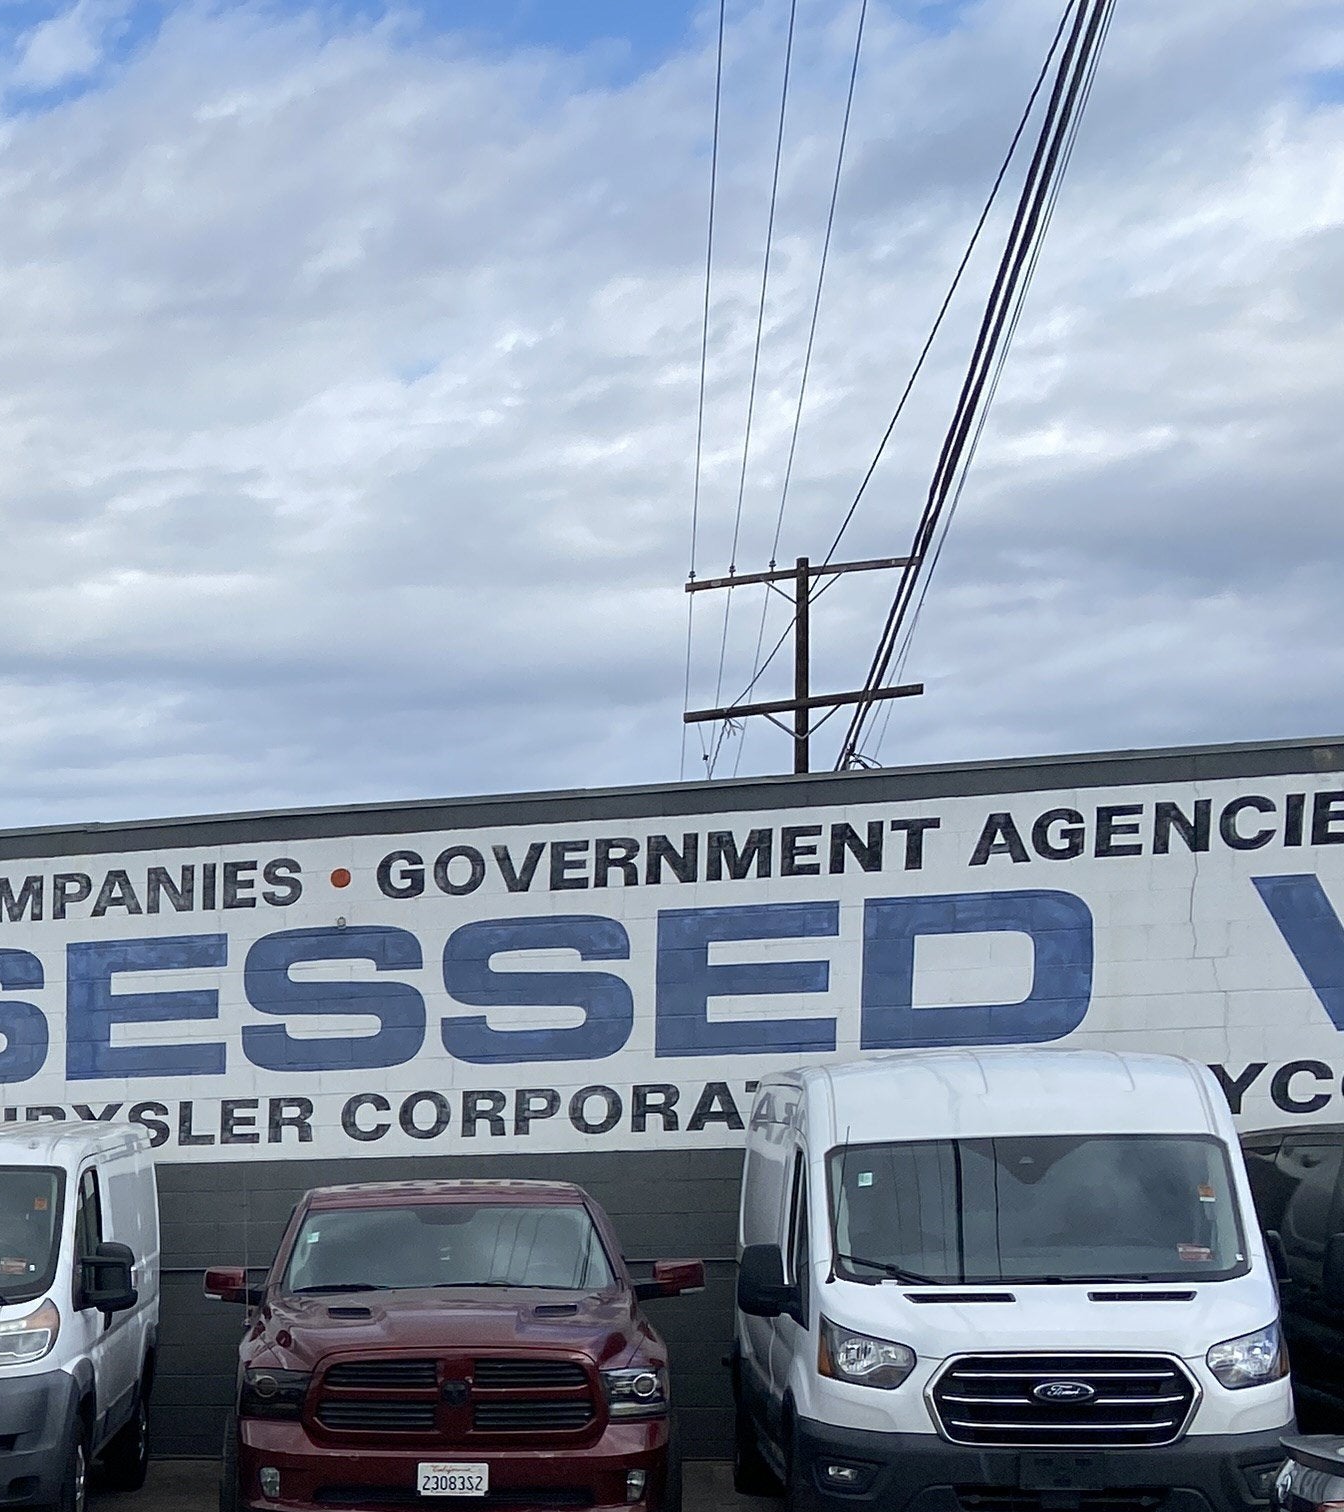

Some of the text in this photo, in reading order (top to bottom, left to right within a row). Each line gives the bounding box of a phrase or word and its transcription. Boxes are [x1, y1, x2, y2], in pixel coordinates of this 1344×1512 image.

[377, 816, 941, 900] GOVERNMENT
[968, 791, 1344, 867] AGENCIE
[1207, 1059, 1344, 1115] YC
[422, 1475, 483, 1491] 23083S2
